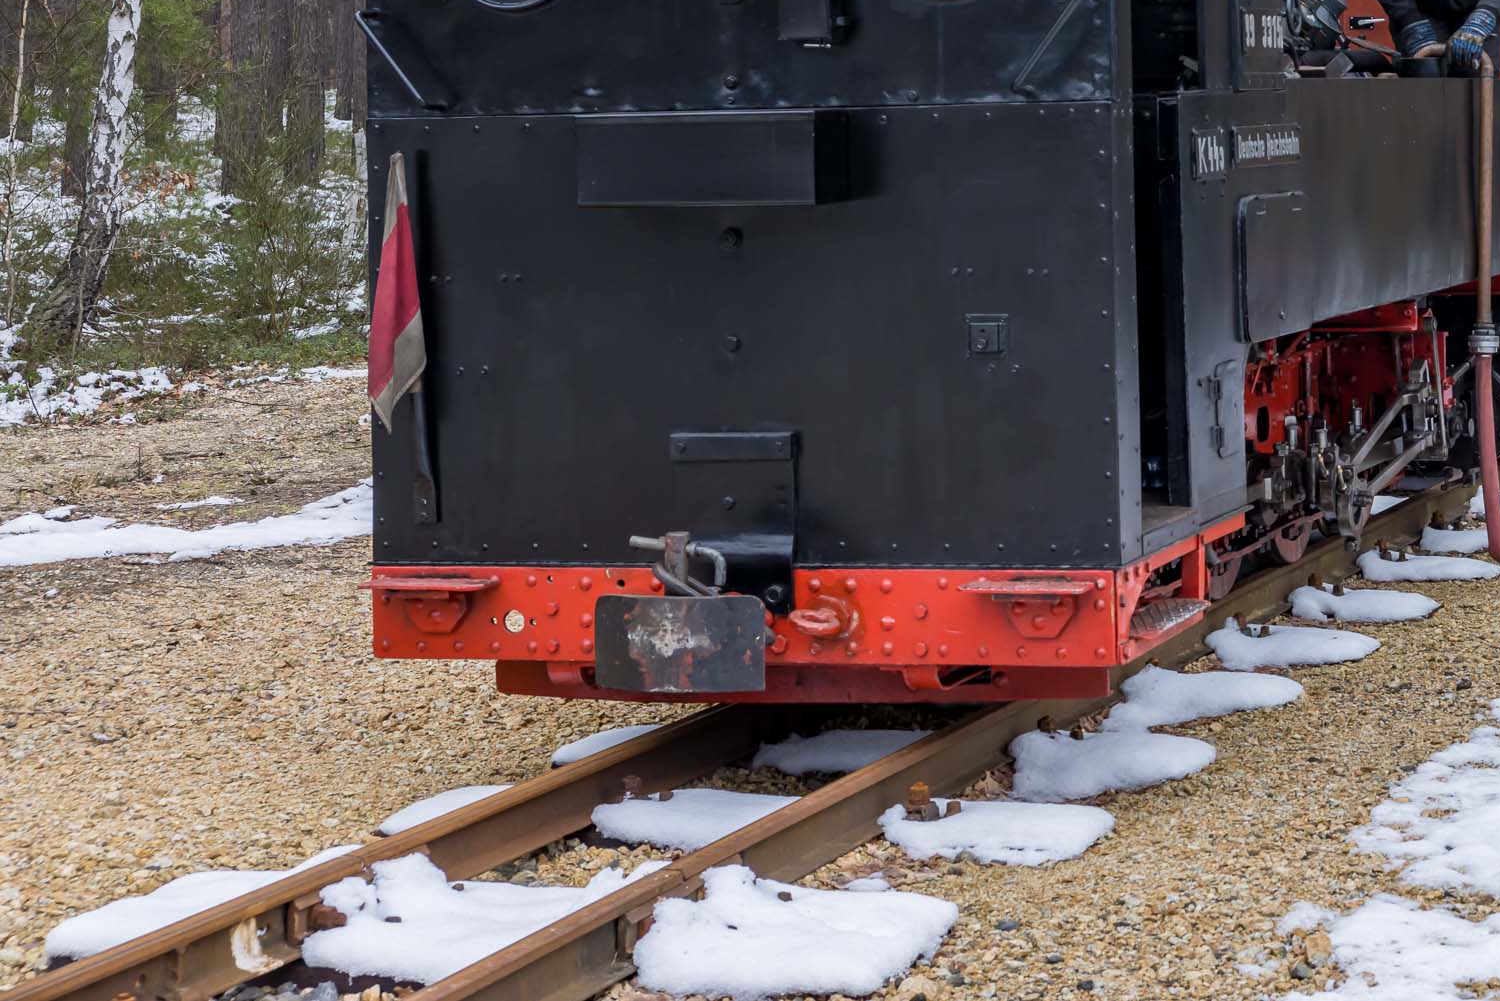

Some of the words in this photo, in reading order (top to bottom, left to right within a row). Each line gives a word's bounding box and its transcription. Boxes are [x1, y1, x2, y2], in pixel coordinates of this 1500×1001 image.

[1244, 13, 1256, 48] 99
[1237, 132, 1265, 160] Deutsche
[1266, 130, 1300, 161] Reichsbahn
